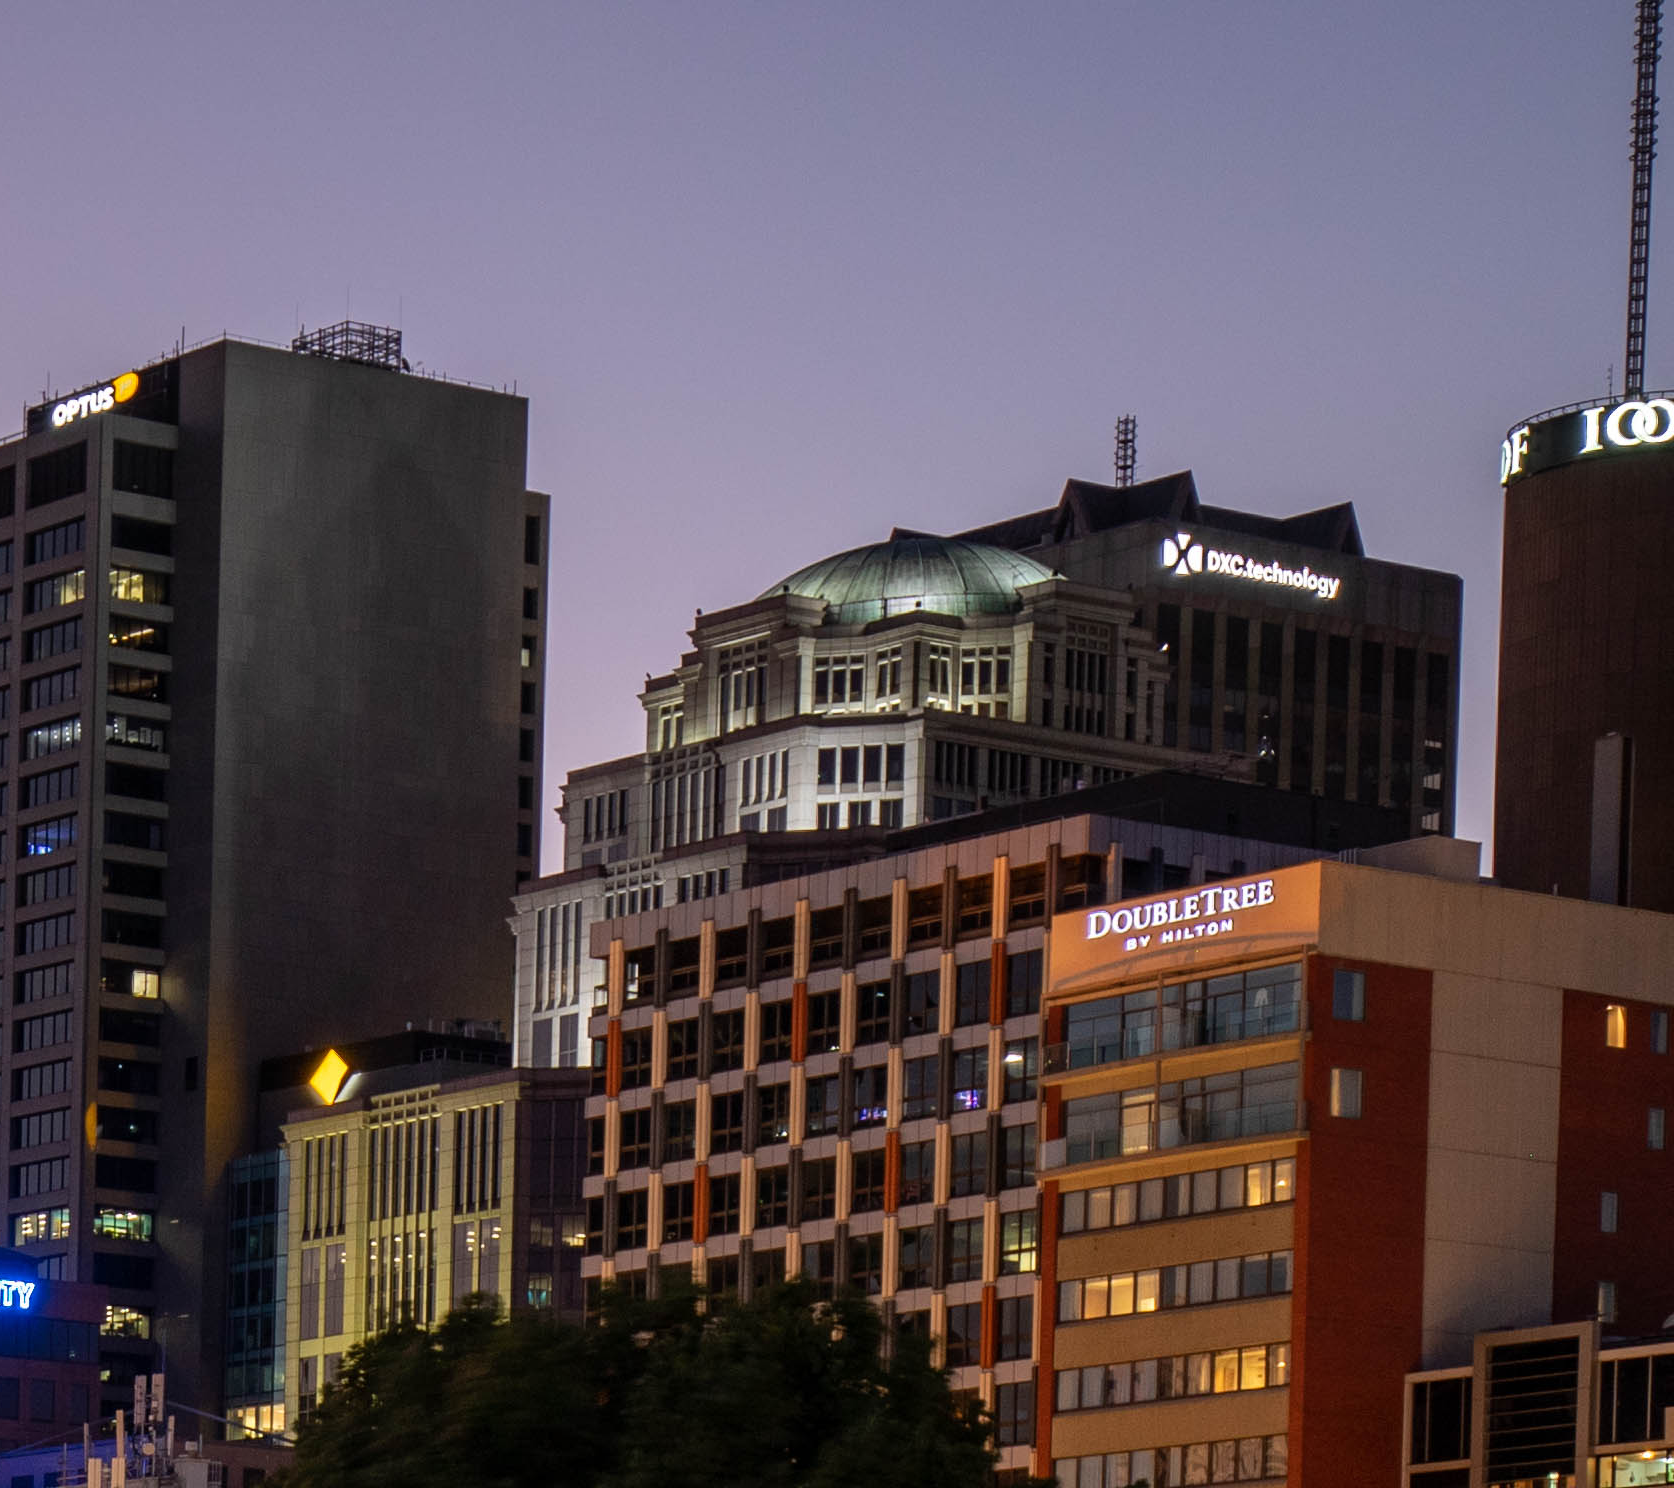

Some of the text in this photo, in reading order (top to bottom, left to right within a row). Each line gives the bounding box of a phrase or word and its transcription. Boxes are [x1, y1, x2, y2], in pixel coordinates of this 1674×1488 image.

[52, 386, 114, 427] OPTUS
[1207, 549, 1341, 599] DXC.technology
[1125, 918, 1234, 951] BY HILTON
